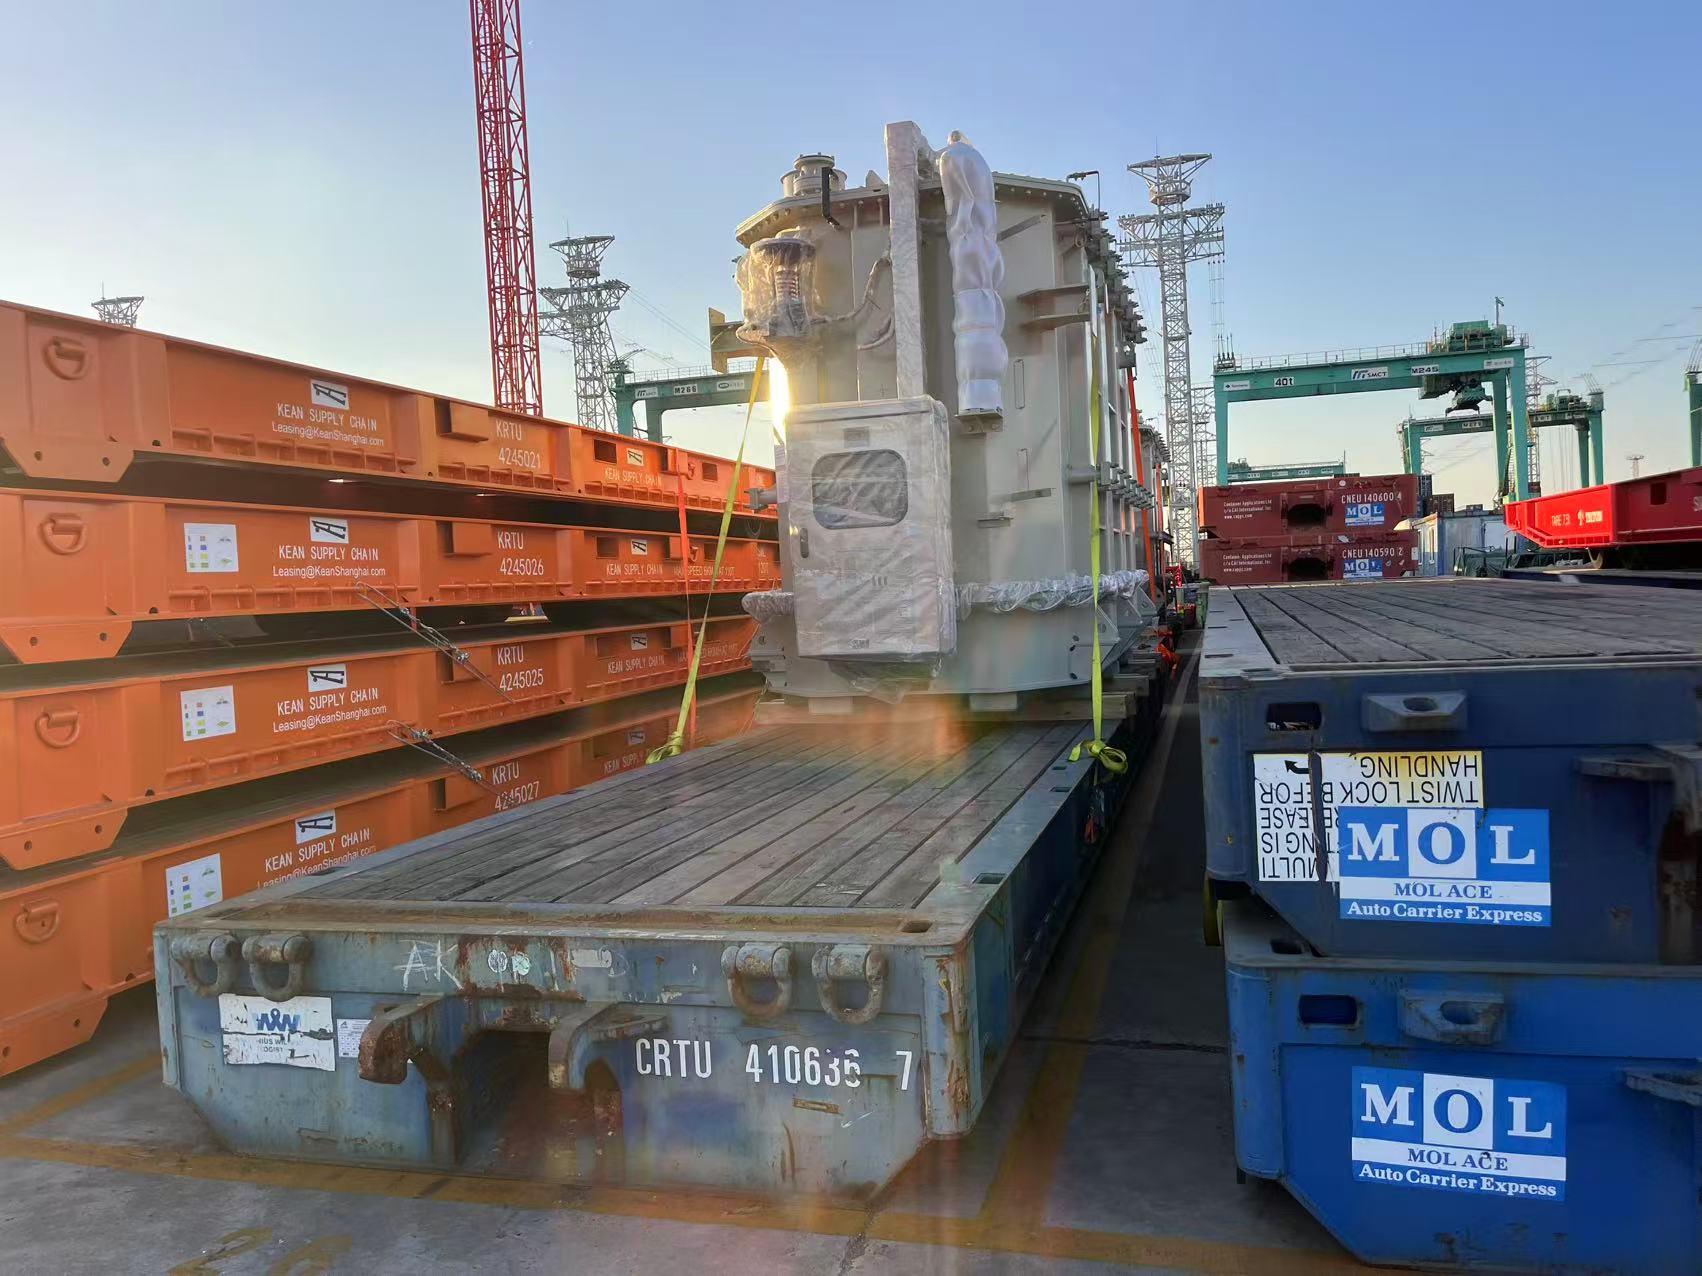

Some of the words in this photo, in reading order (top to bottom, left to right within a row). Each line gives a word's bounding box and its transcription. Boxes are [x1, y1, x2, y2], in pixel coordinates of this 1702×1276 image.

[674, 385, 697, 394] M266
[277, 402, 304, 420] KEAN
[309, 408, 344, 426] SUPPLY
[349, 415, 377, 431] CHAIN
[495, 420, 522, 440] KRTU
[498, 447, 541, 468] 4245021
[1341, 494, 1362, 504] CNEU
[1363, 492, 1394, 502] 140600
[1346, 505, 1383, 516] MOL
[497, 531, 524, 549] KRTU
[279, 545, 305, 559] KEAN
[310, 546, 346, 560] SUPPLY
[351, 547, 379, 561] CHAIN
[1342, 548, 1363, 559] CNEU
[1365, 547, 1395, 557] 140590
[272, 565, 386, 579] Leasing@KeanShanghai.com
[500, 557, 545, 576] 4245026
[606, 563, 621, 576] KEAN
[624, 563, 645, 576] SUPPLY
[646, 563, 663, 575] CHAIN
[497, 645, 524, 666] KRTU
[607, 661, 623, 675] KEAN
[625, 657, 646, 672] SUPPLY
[499, 668, 544, 692] 4245025
[277, 698, 304, 716] KEAN
[309, 692, 345, 710] SUPPLY
[350, 687, 378, 704] CHAIN
[272, 704, 387, 733] Leasing@KeanShanghai.com
[492, 760, 520, 785] KRTU
[1354, 754, 1478, 779] HANDLING.
[494, 780, 540, 811] 4245027
[1339, 780, 1400, 804] LOCK
[1407, 780, 1478, 804] TWIST
[265, 851, 293, 873] KEAN
[298, 838, 336, 862] SUPPLY
[341, 827, 370, 848] CHAIN
[1347, 821, 1536, 866] MOL
[1394, 882, 1443, 899] MOL
[1448, 883, 1493, 899] ACE
[1347, 901, 1393, 918] Auto
[1393, 902, 1465, 920] Carrier
[1465, 905, 1543, 923] Express
[635, 1038, 712, 1079] CRTU
[895, 1050, 913, 1091] 7
[1360, 1082, 1552, 1139] MOL
[1407, 1147, 1457, 1167] MOL
[1463, 1152, 1509, 1172] ACE
[1358, 1163, 1404, 1182] Auto
[1405, 1168, 1478, 1191] Carrier
[1479, 1176, 1557, 1198] Express
